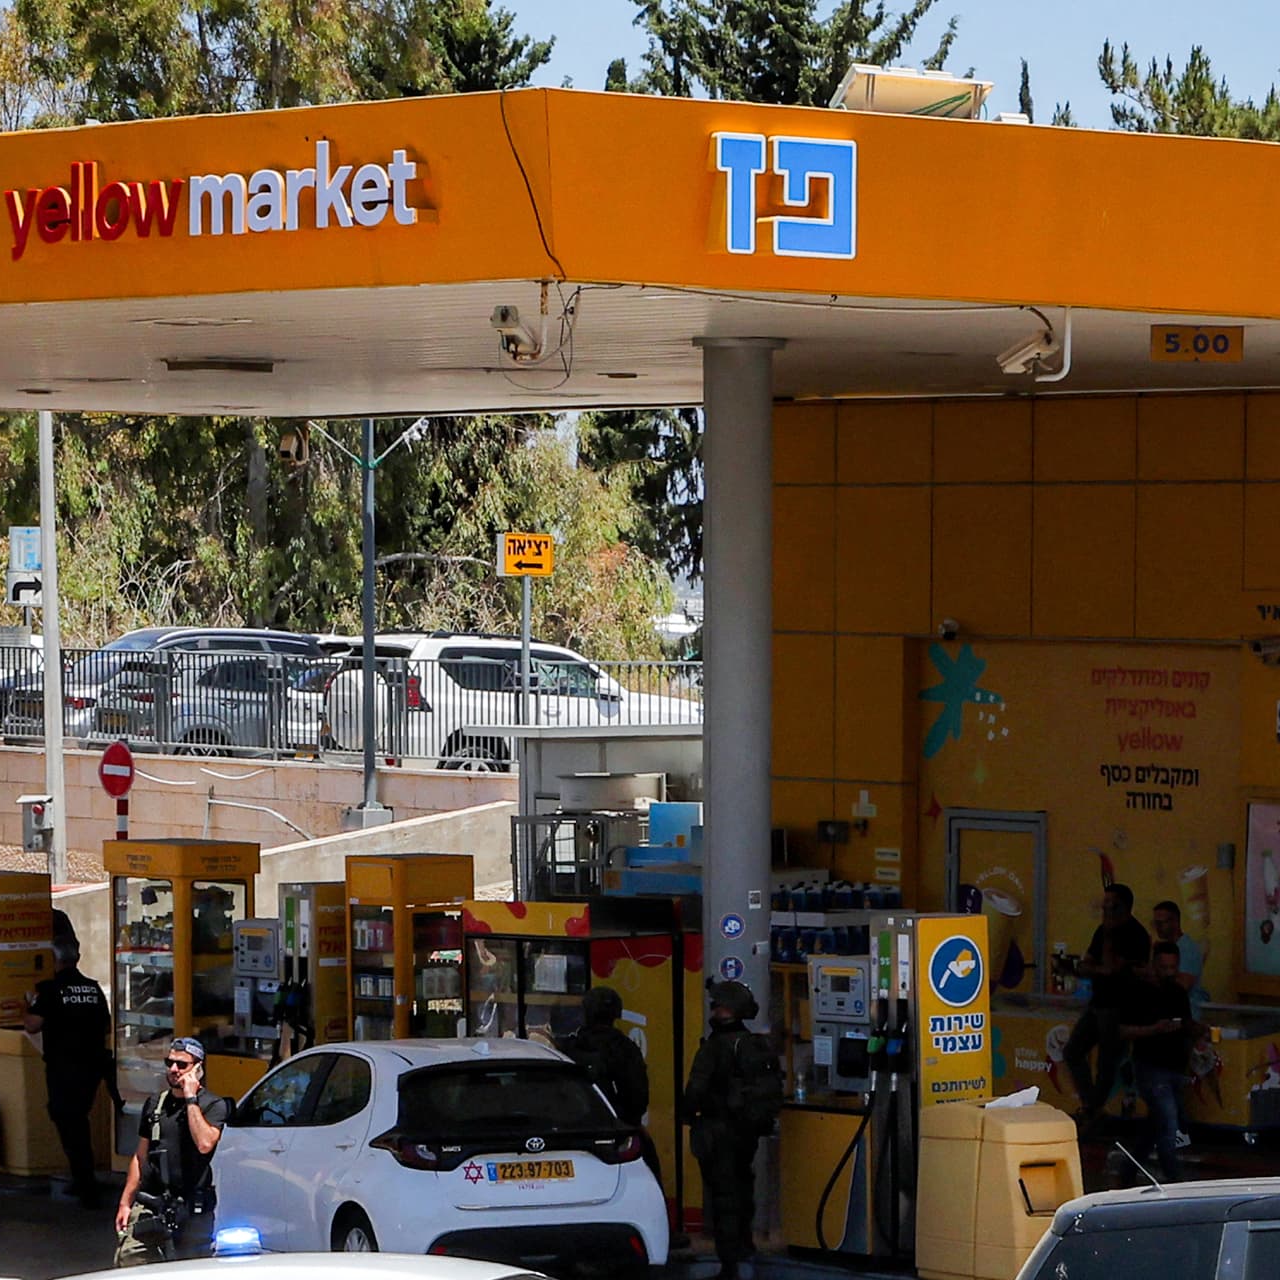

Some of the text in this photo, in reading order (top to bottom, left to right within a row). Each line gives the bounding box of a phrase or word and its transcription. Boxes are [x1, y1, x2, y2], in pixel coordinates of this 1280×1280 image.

[711, 131, 858, 260] פז
[1166, 333, 1229, 354] 5.00
[507, 538, 549, 557] יציאה
[1118, 726, 1184, 753] yellow
[1100, 763, 1200, 789] ומקבלים כסף
[63, 994, 98, 1005] POLICE
[930, 1013, 984, 1032] שירות
[934, 1034, 983, 1053] עצמי
[931, 1076, 987, 1093] לשירותכם
